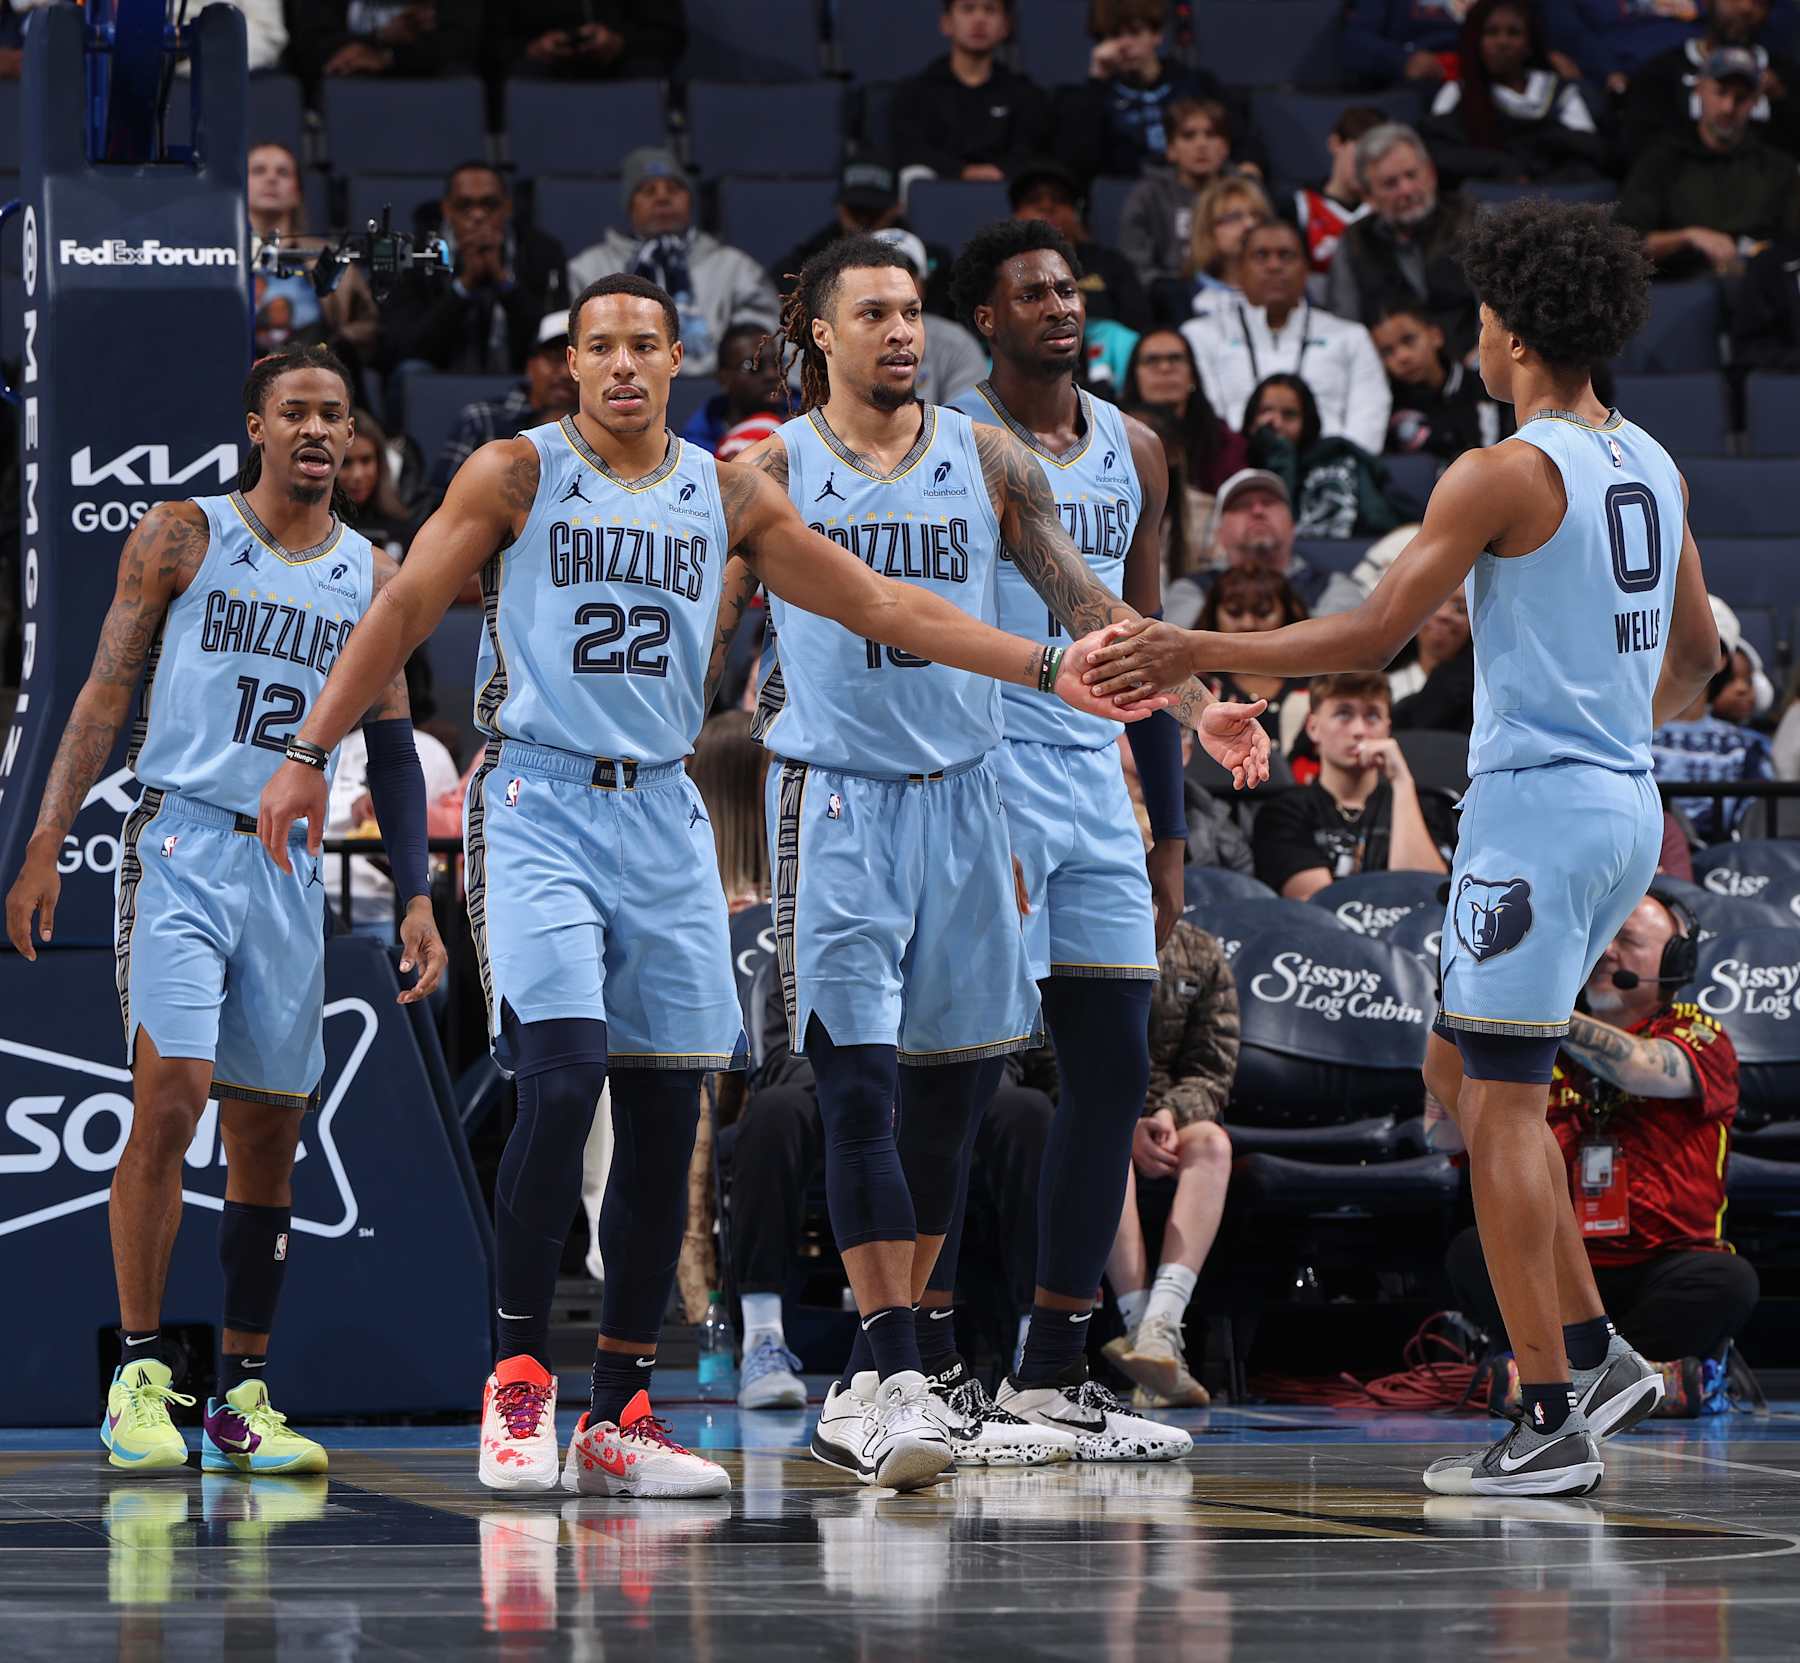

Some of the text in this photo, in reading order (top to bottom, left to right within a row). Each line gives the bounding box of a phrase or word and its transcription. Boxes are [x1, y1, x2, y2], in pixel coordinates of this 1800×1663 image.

[59, 239, 240, 266] FedExForum
[668, 504, 710, 519] Robinhood
[923, 487, 968, 497] Robinhood
[72, 500, 163, 533] GOS
[1605, 482, 1662, 593] 0
[550, 521, 707, 602] GRIZZLIES
[808, 517, 968, 583] IZZLIES
[573, 602, 671, 678] 22
[1614, 607, 1660, 655] WELLS
[232, 675, 306, 754] 12
[1251, 952, 1382, 1003] Sissy's
[1296, 985, 1424, 1024] Log Cabin
[1744, 989, 1794, 1020] Log
